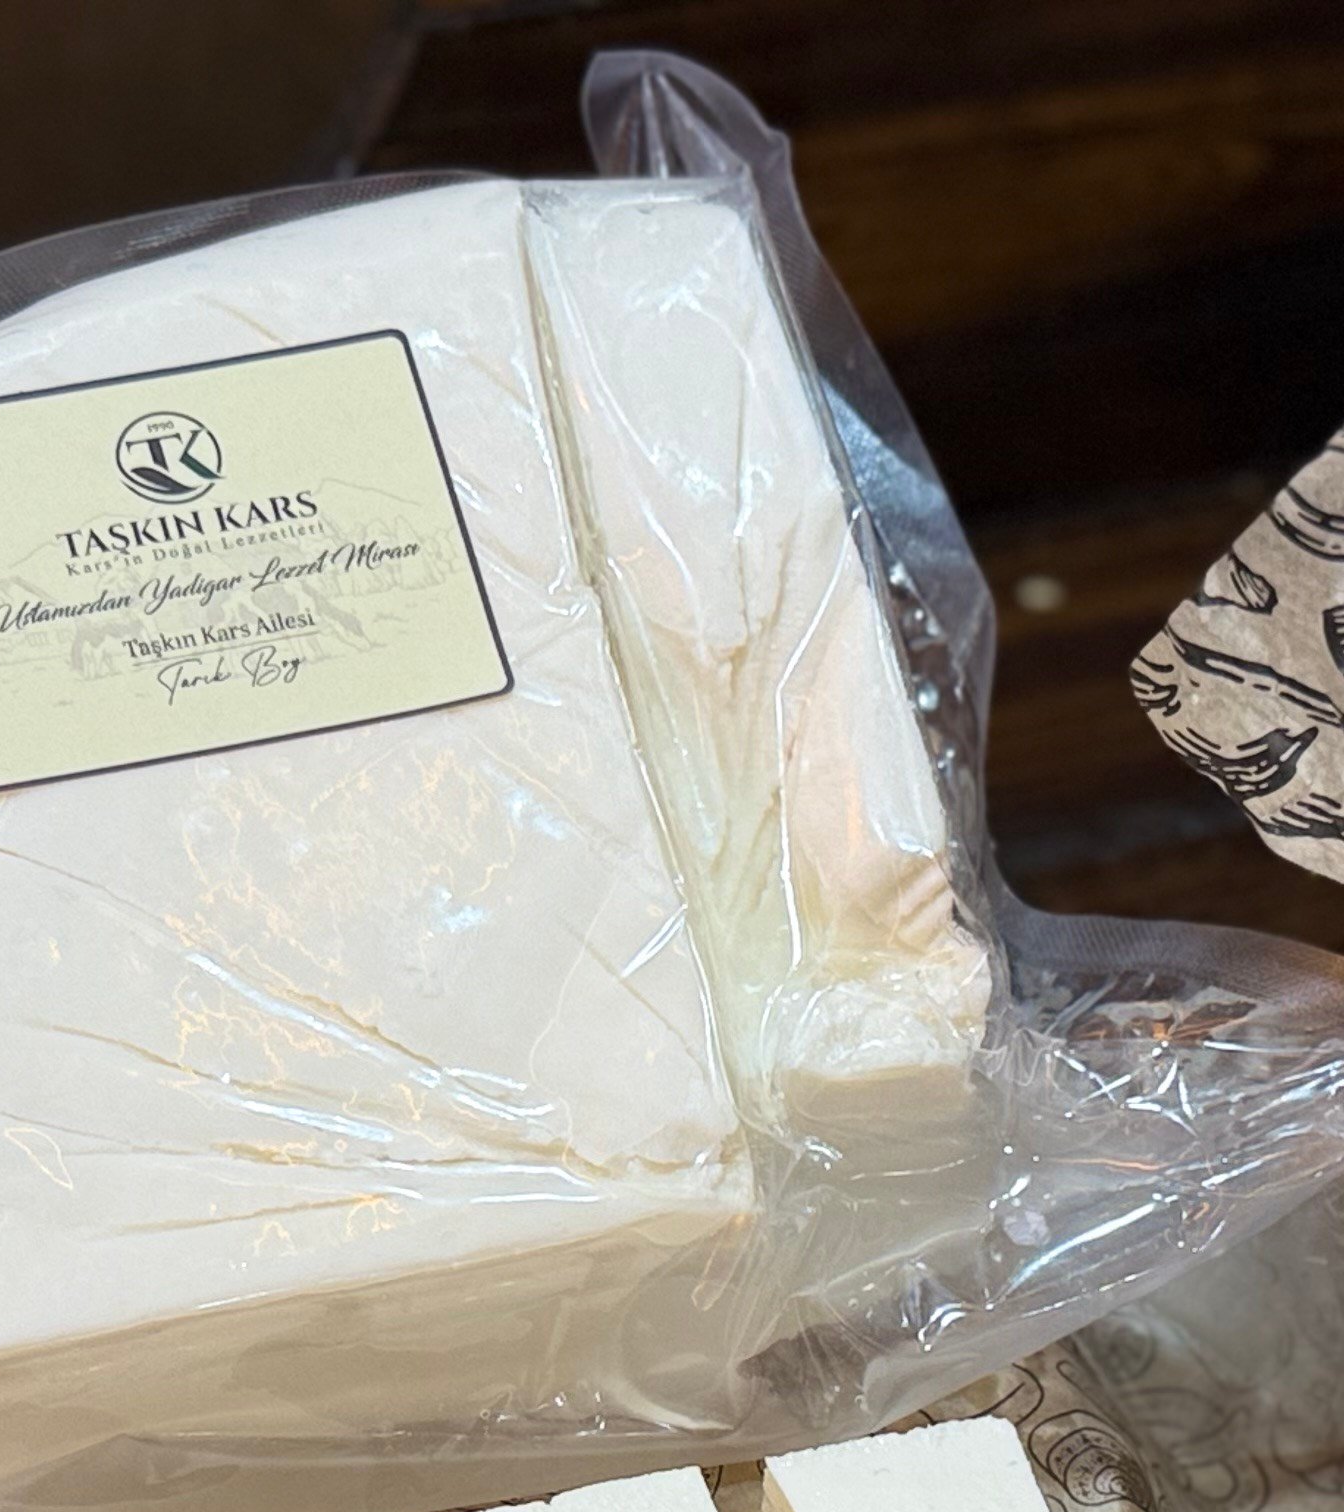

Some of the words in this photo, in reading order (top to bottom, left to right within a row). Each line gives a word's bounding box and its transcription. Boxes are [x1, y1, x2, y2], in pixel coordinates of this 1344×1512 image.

[56, 511, 204, 562] TAŞKIN
[214, 491, 320, 532] KARS
[138, 573, 243, 616] Yadigar
[247, 554, 328, 591] Lezzet
[122, 630, 197, 659] Taşkın
[201, 621, 251, 643] Kars
[255, 608, 318, 636] Ailesi
